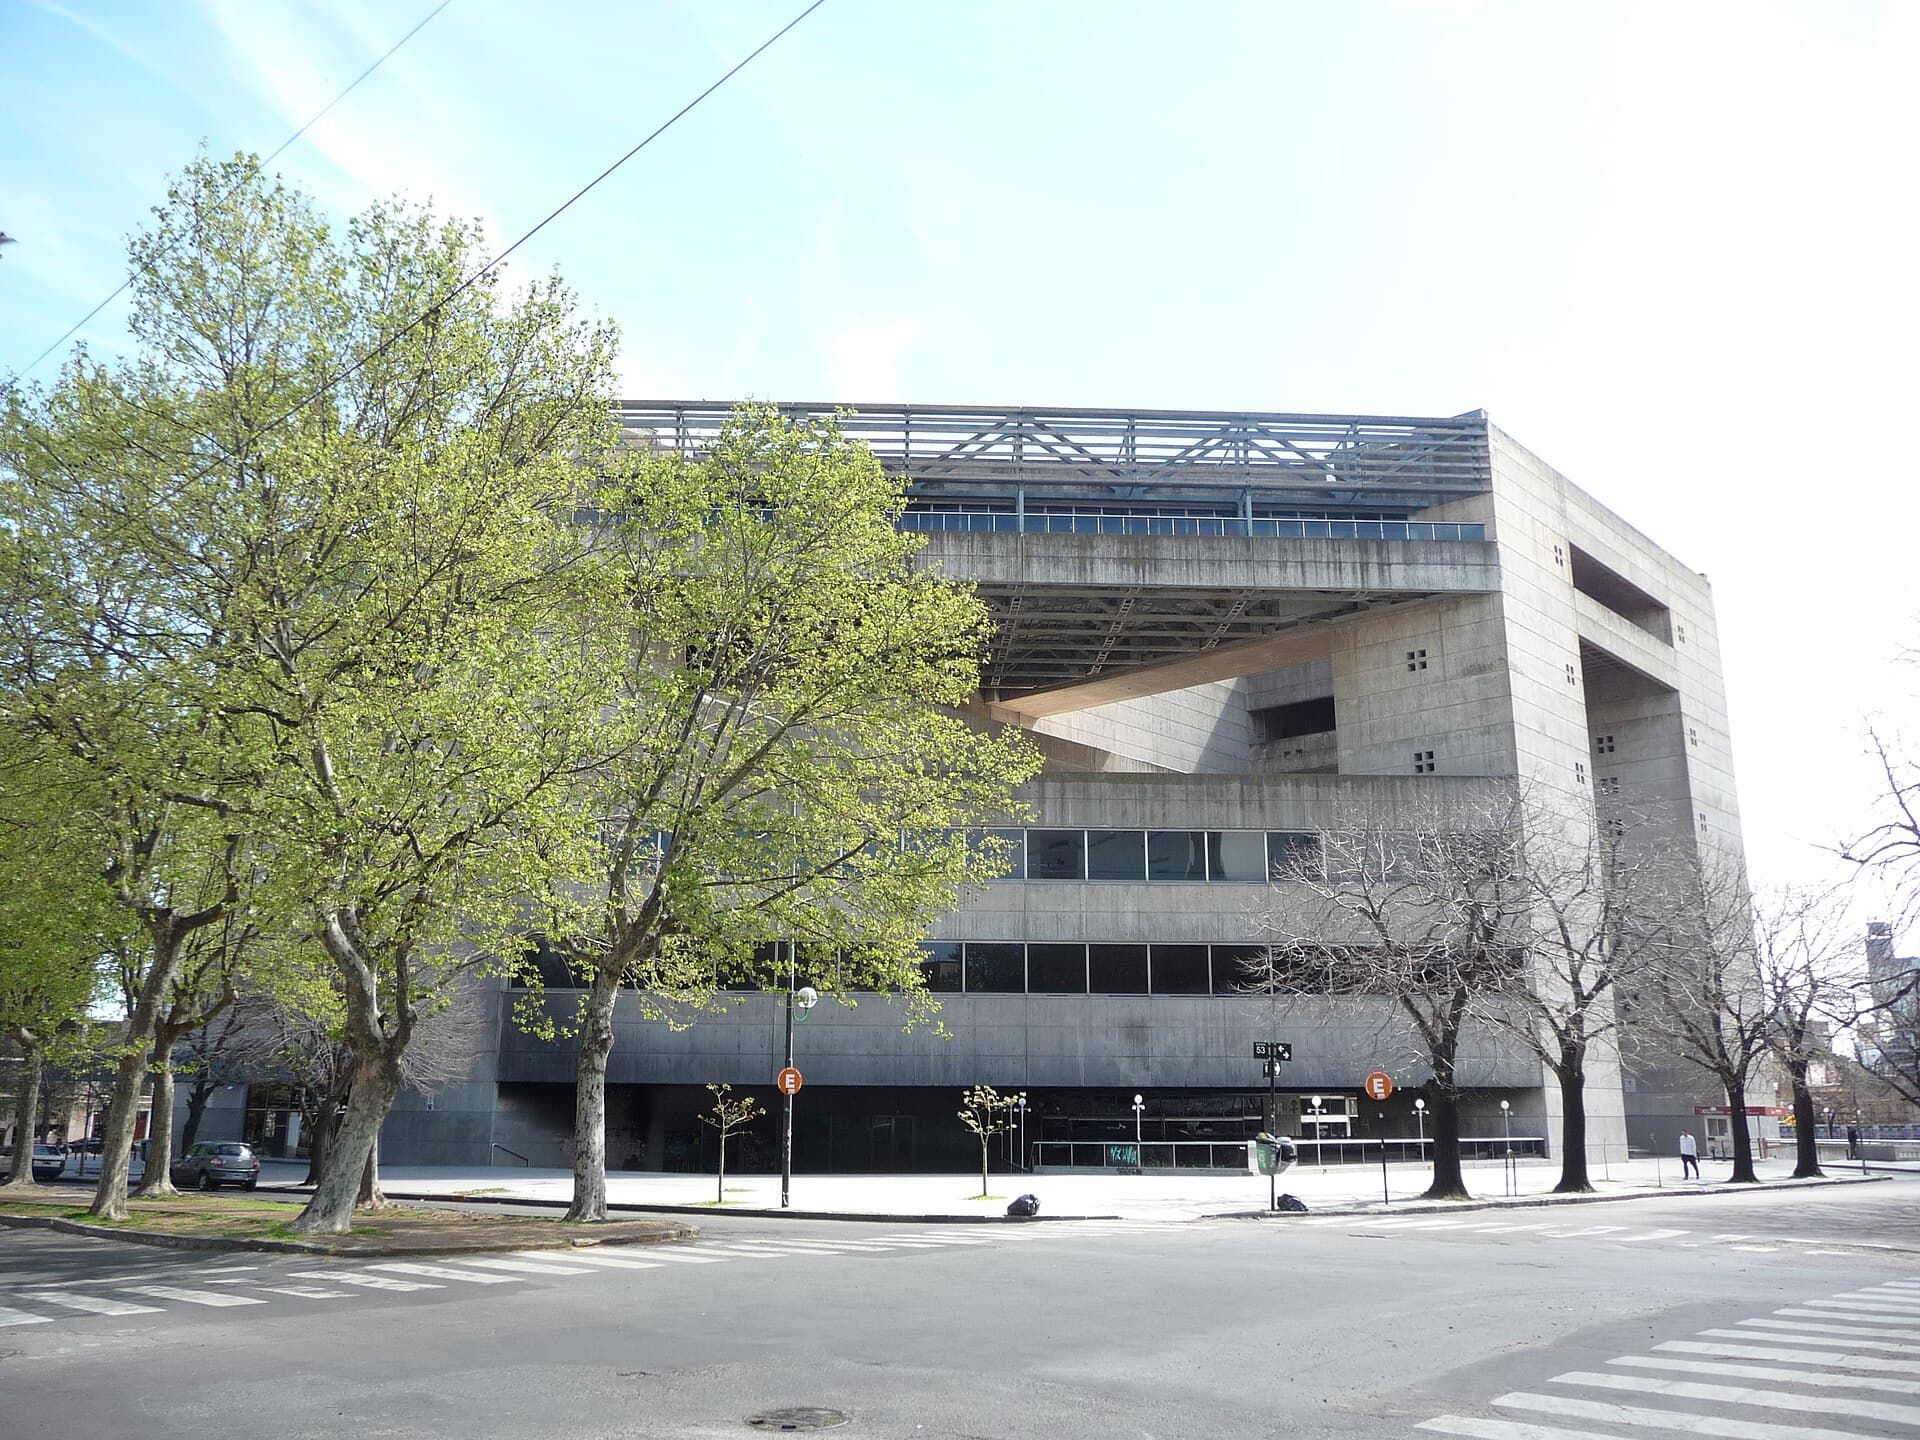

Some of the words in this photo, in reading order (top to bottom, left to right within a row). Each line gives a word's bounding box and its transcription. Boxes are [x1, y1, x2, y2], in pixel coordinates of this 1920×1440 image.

[1256, 1046, 1265, 1054] 53
[785, 1073, 795, 1089] E
[1373, 1078, 1384, 1093] E
